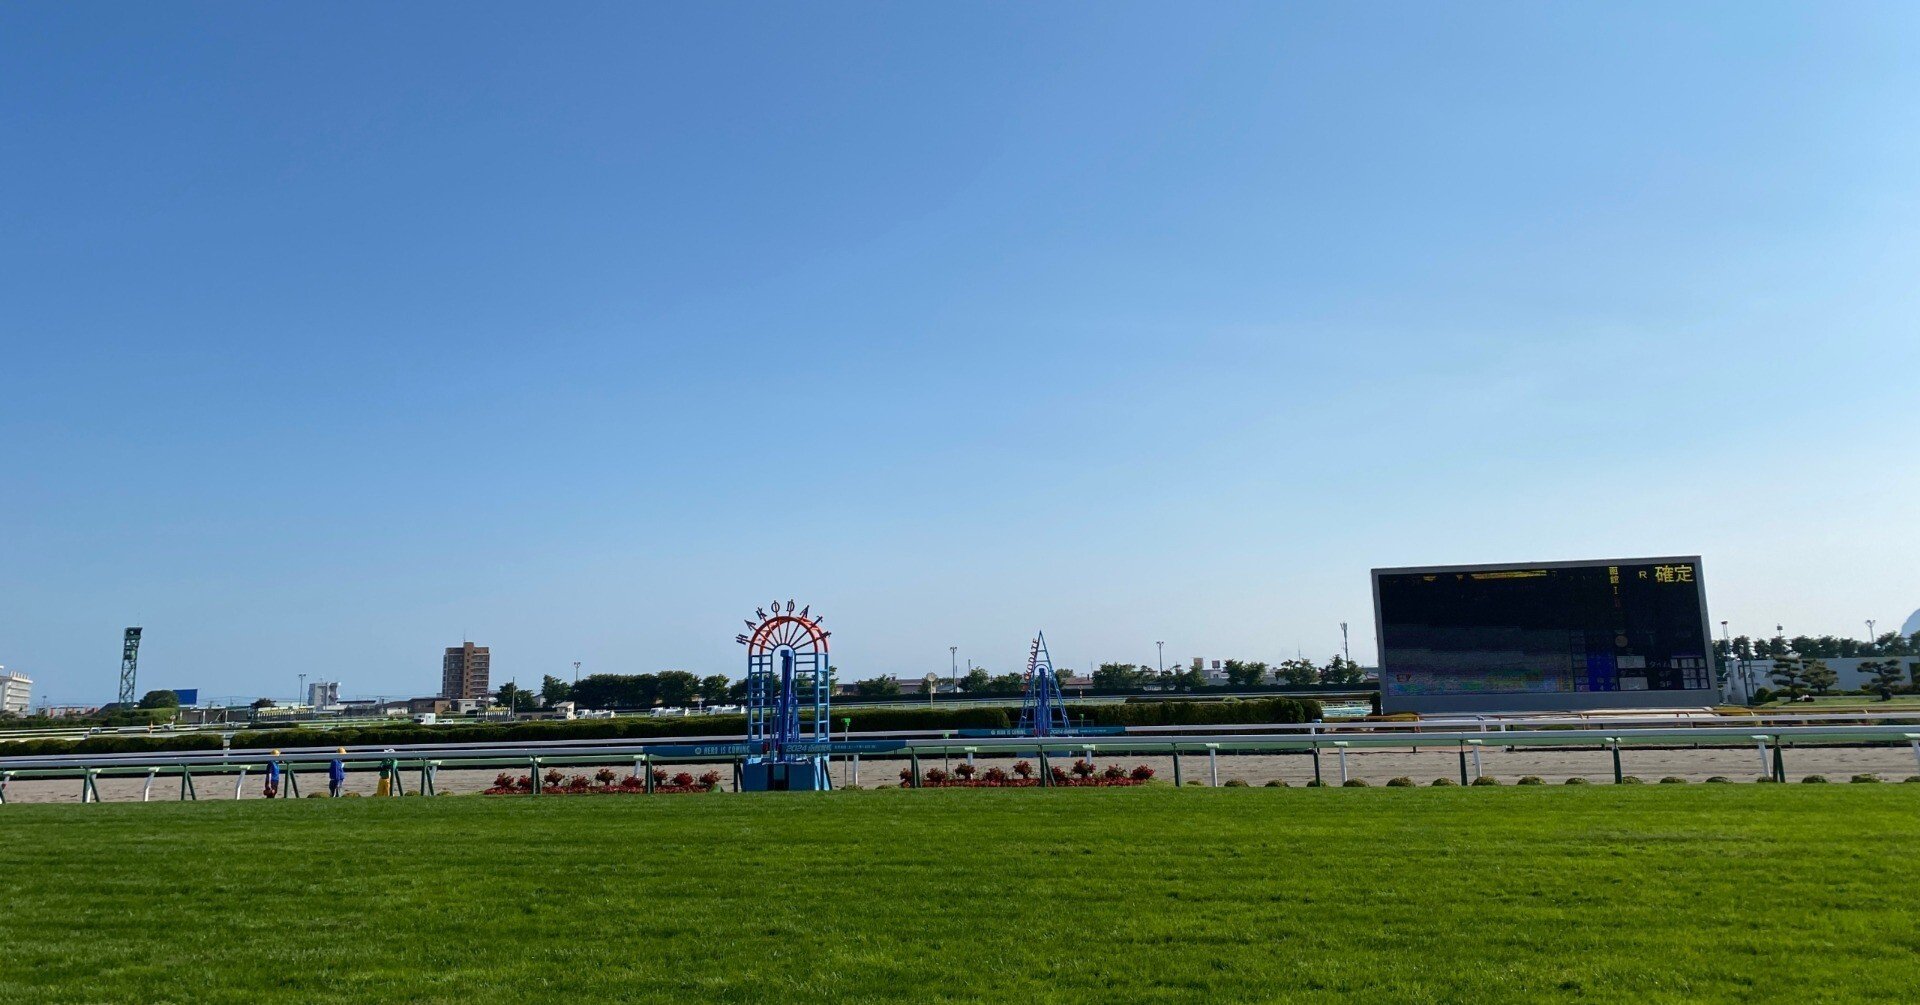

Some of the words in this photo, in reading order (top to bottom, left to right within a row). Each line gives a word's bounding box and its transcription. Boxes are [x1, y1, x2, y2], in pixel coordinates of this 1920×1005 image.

[1638, 570, 1648, 579] R
[1655, 565, 1694, 583] 確定
[735, 599, 832, 646] HAKODATE
[785, 744, 807, 753] 2024
